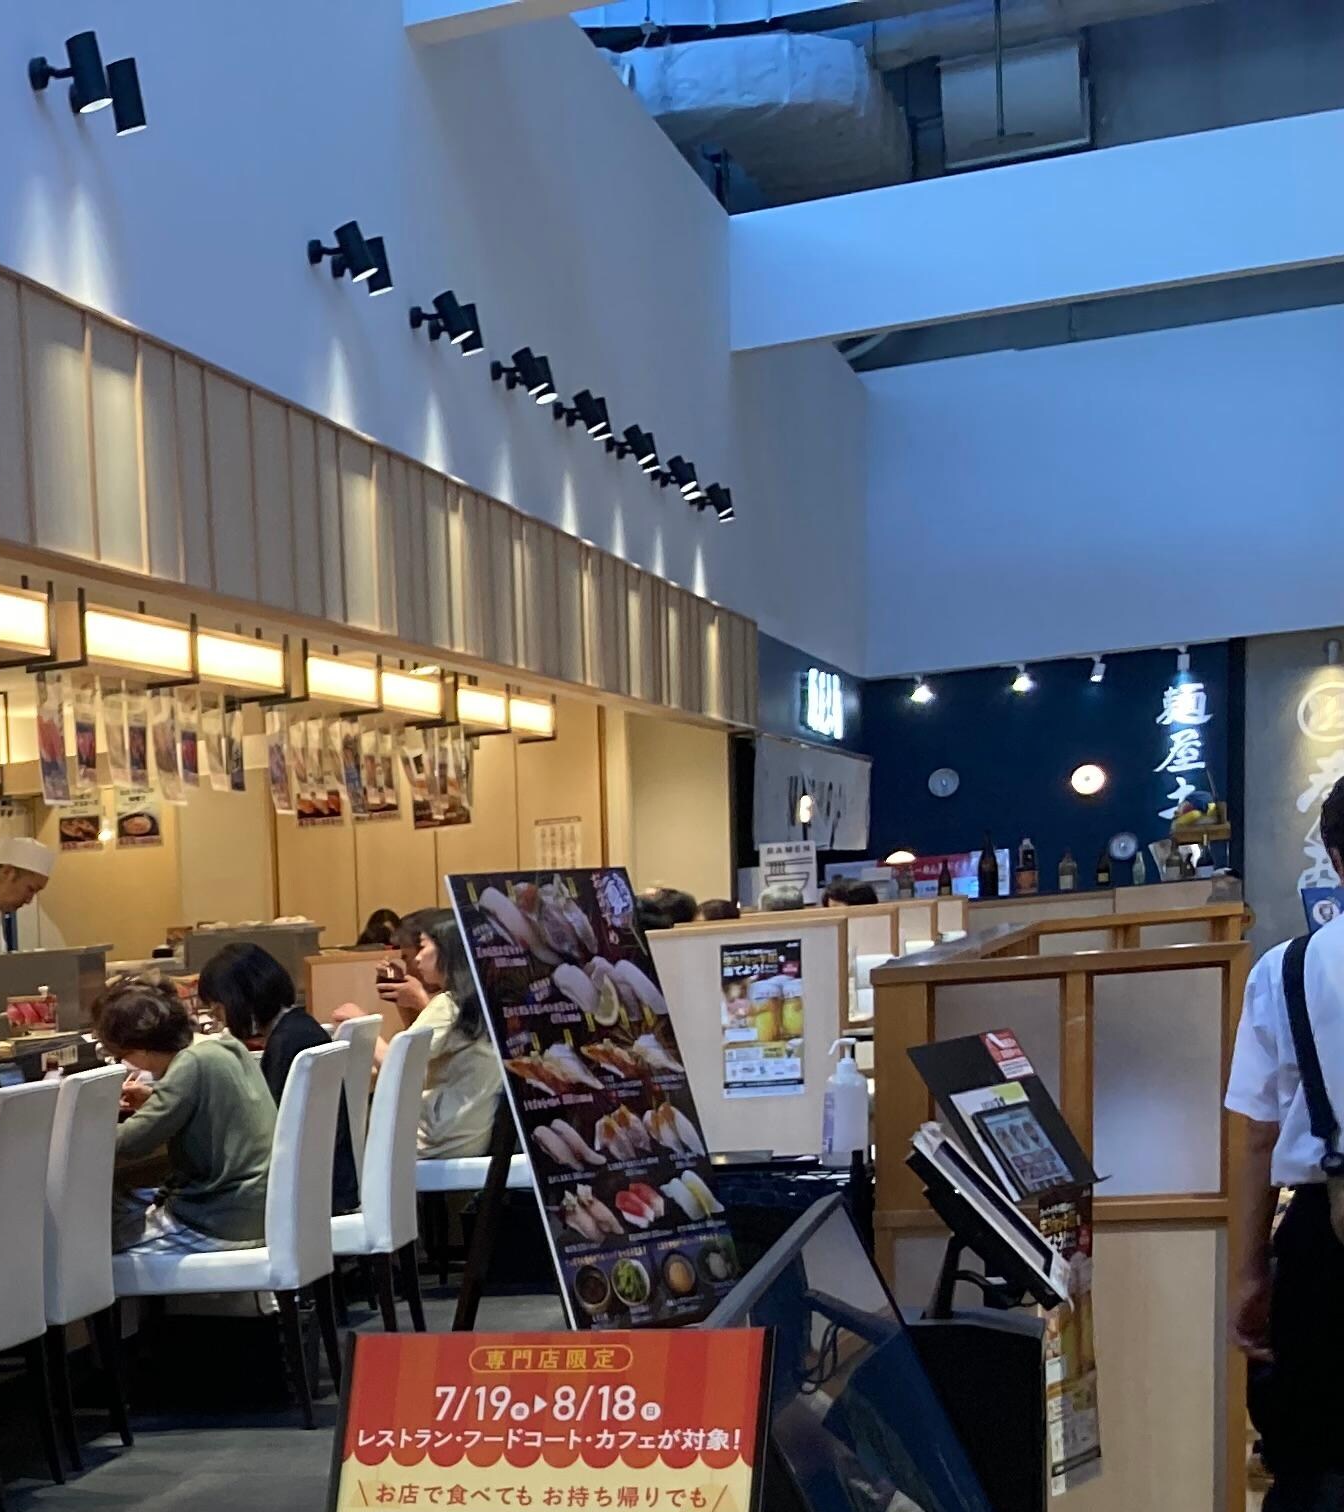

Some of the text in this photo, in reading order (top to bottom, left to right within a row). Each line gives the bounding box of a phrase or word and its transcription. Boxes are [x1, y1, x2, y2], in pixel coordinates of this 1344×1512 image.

[485, 1348, 616, 1371] 専門店限定
[358, 1428, 742, 1452] レストラン・フードコート・カフェが対象!
[376, 1484, 707, 1509] お店で食べても お持ち帰りでも
